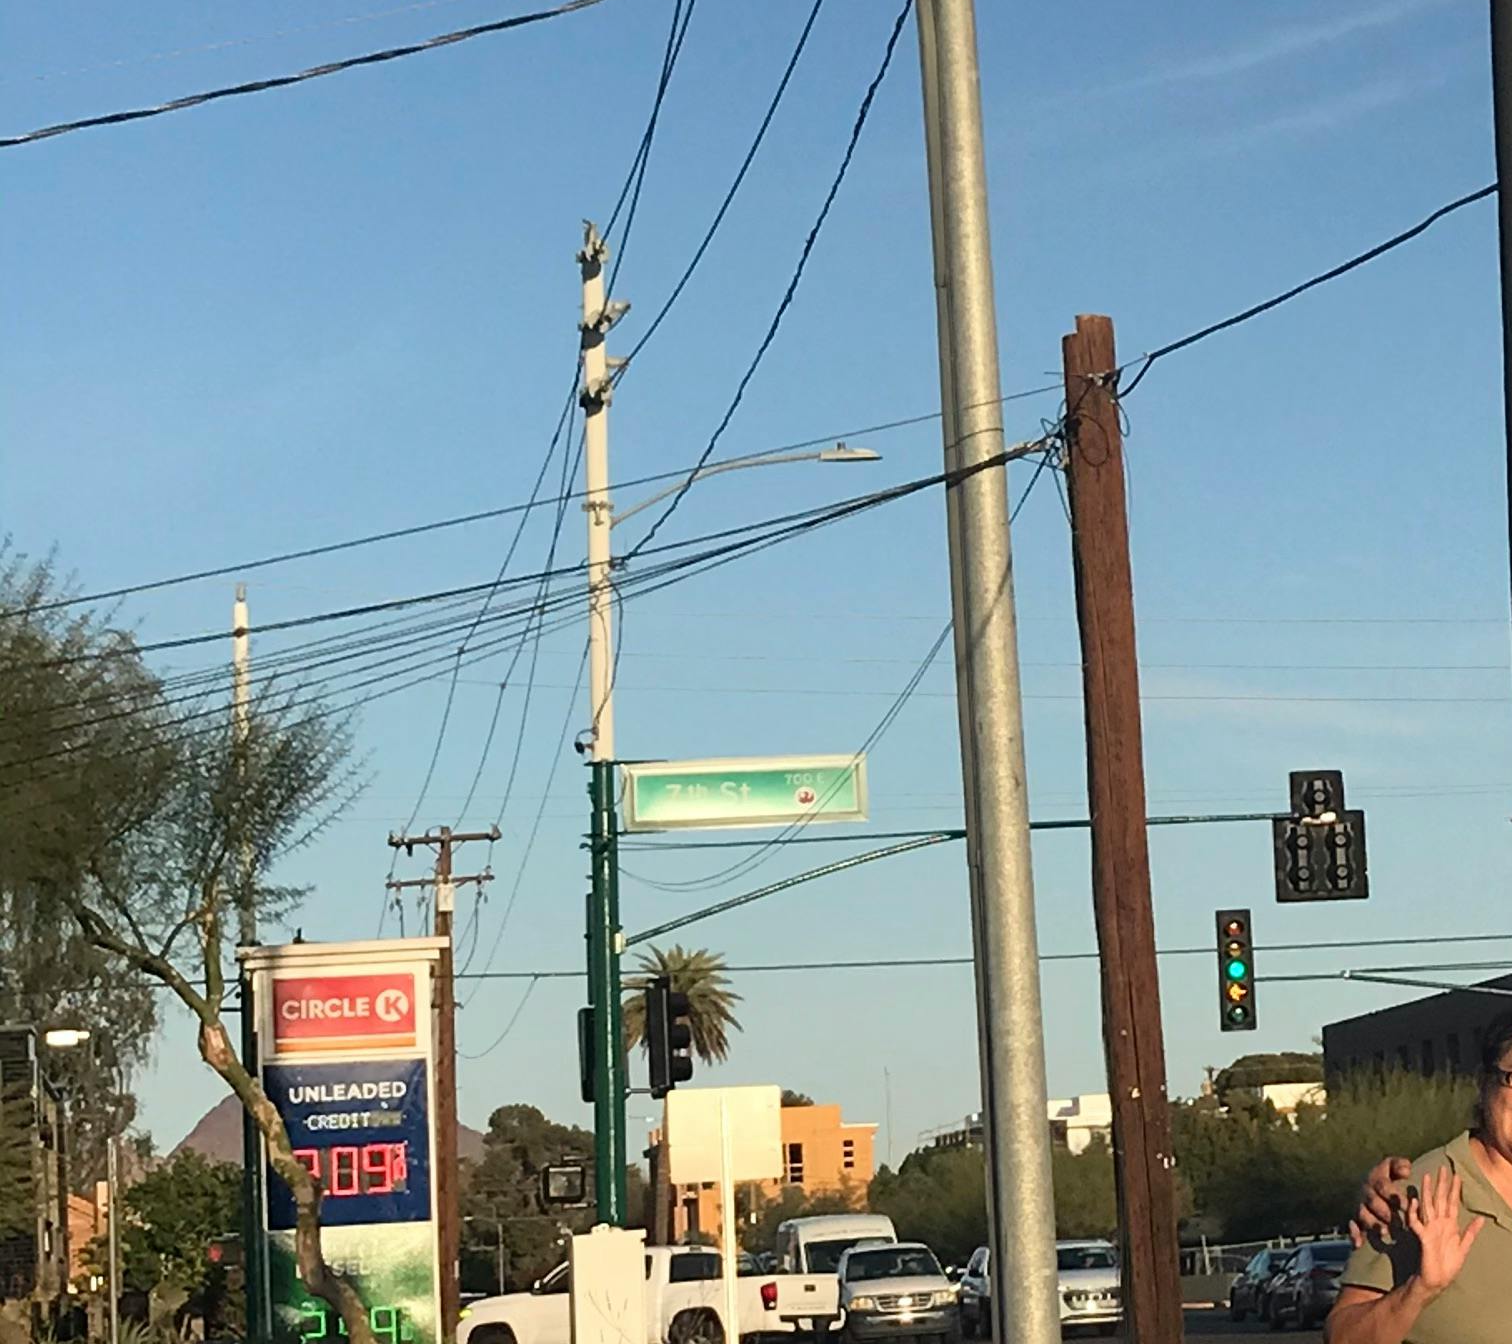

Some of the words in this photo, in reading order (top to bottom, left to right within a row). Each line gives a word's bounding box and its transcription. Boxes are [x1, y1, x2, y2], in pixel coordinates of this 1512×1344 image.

[665, 783, 709, 804] 7th
[720, 781, 751, 803] St
[282, 996, 370, 1021] CIRCLE
[288, 1080, 407, 1104] UNLEADED
[306, 1111, 372, 1131] CREDIT
